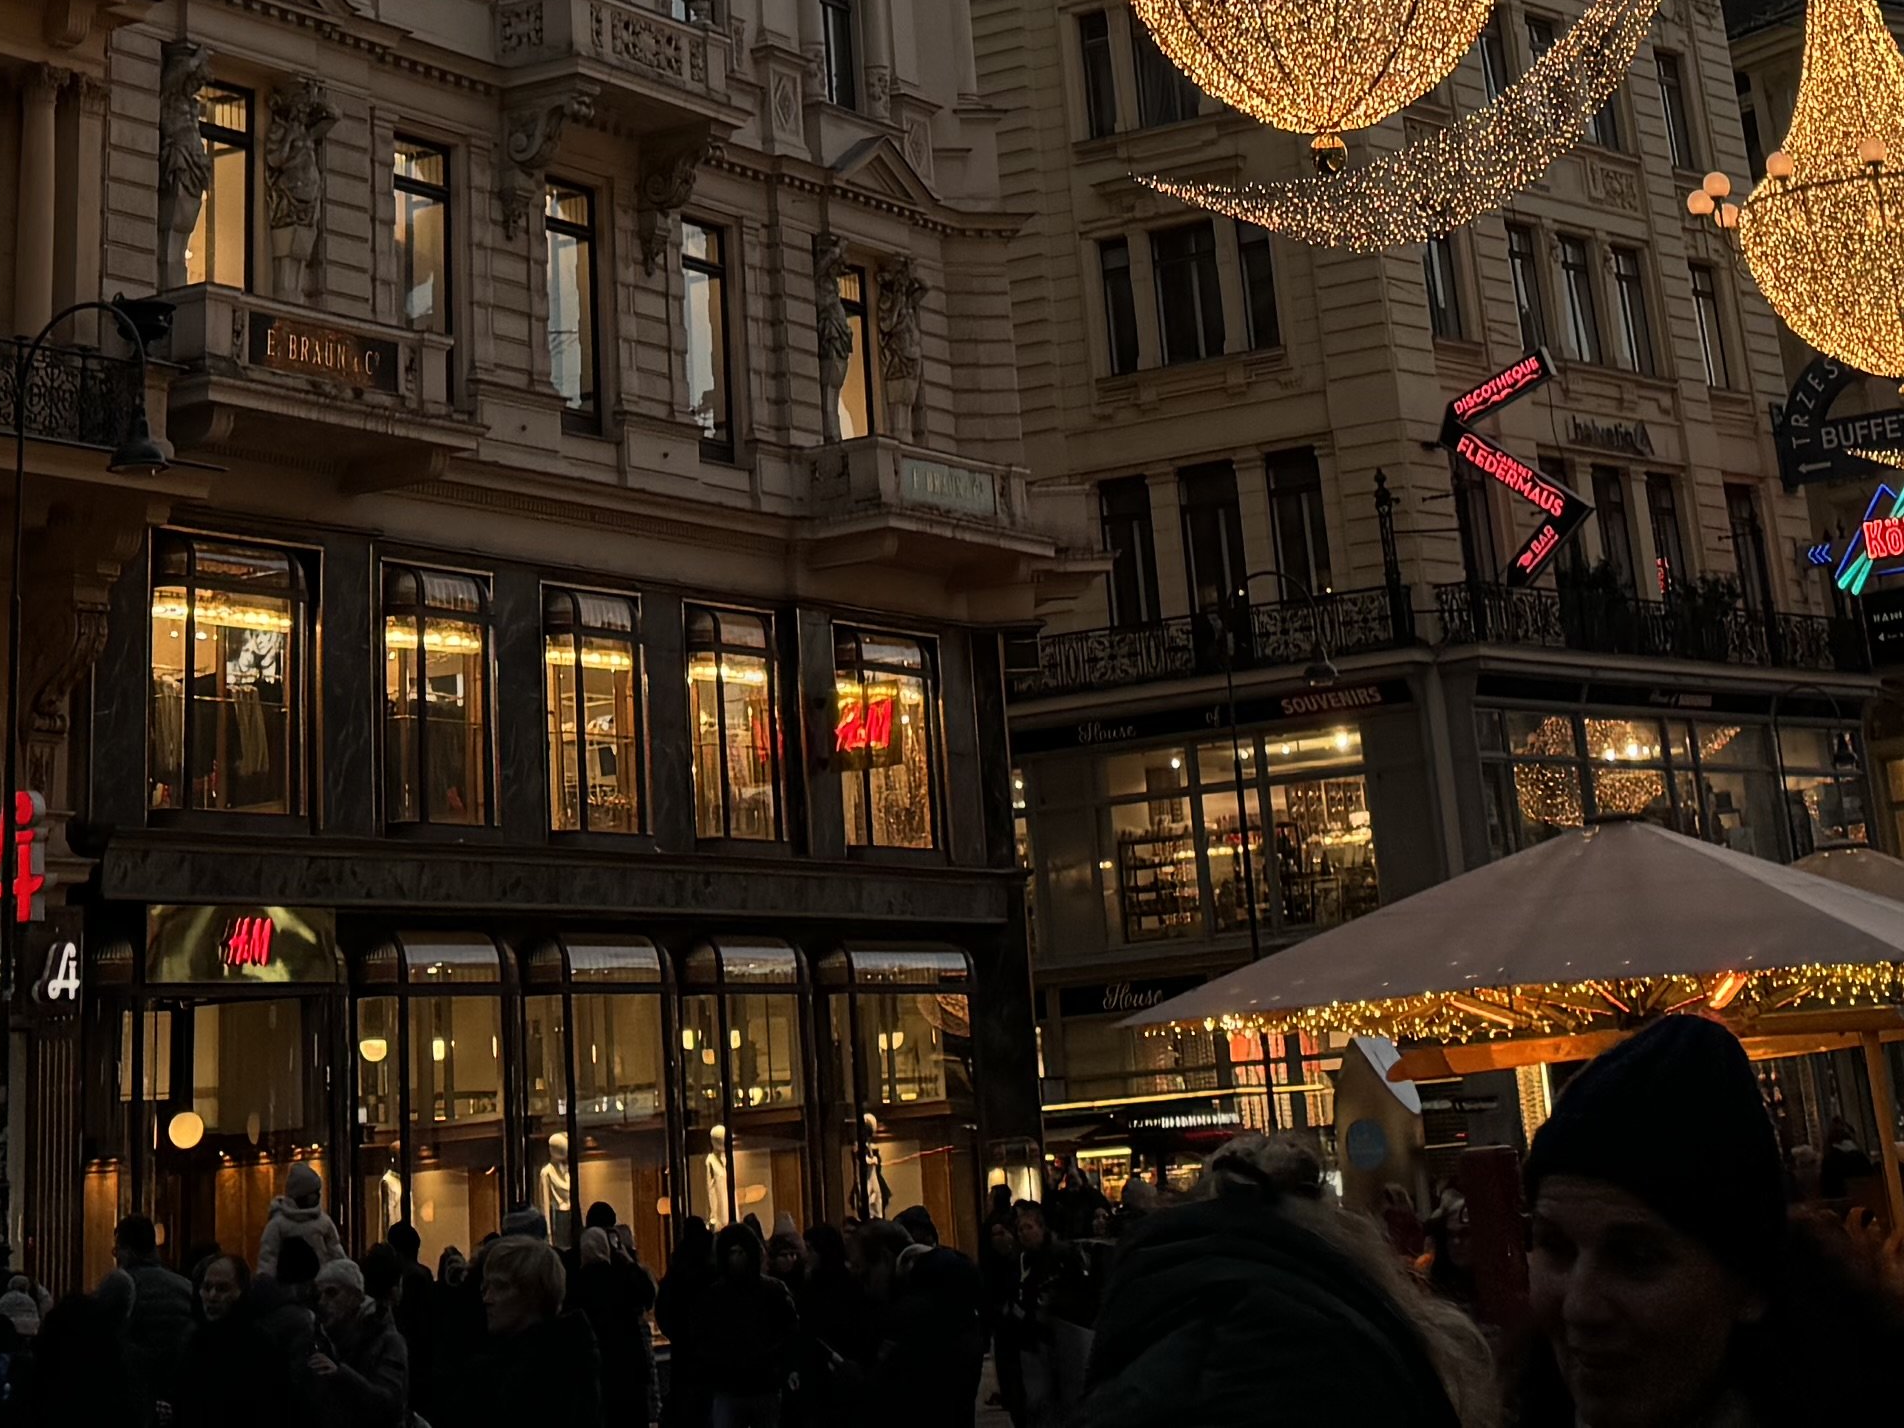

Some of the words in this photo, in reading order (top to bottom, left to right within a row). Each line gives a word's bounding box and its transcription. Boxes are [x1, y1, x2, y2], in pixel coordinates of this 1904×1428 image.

[1453, 355, 1541, 416] DISCOTHEQUE
[1456, 436, 1566, 519] FLEDERMAUS
[1530, 524, 1556, 555] BAR
[1077, 720, 1136, 744] House
[1281, 686, 1382, 716] SOUVENIRS
